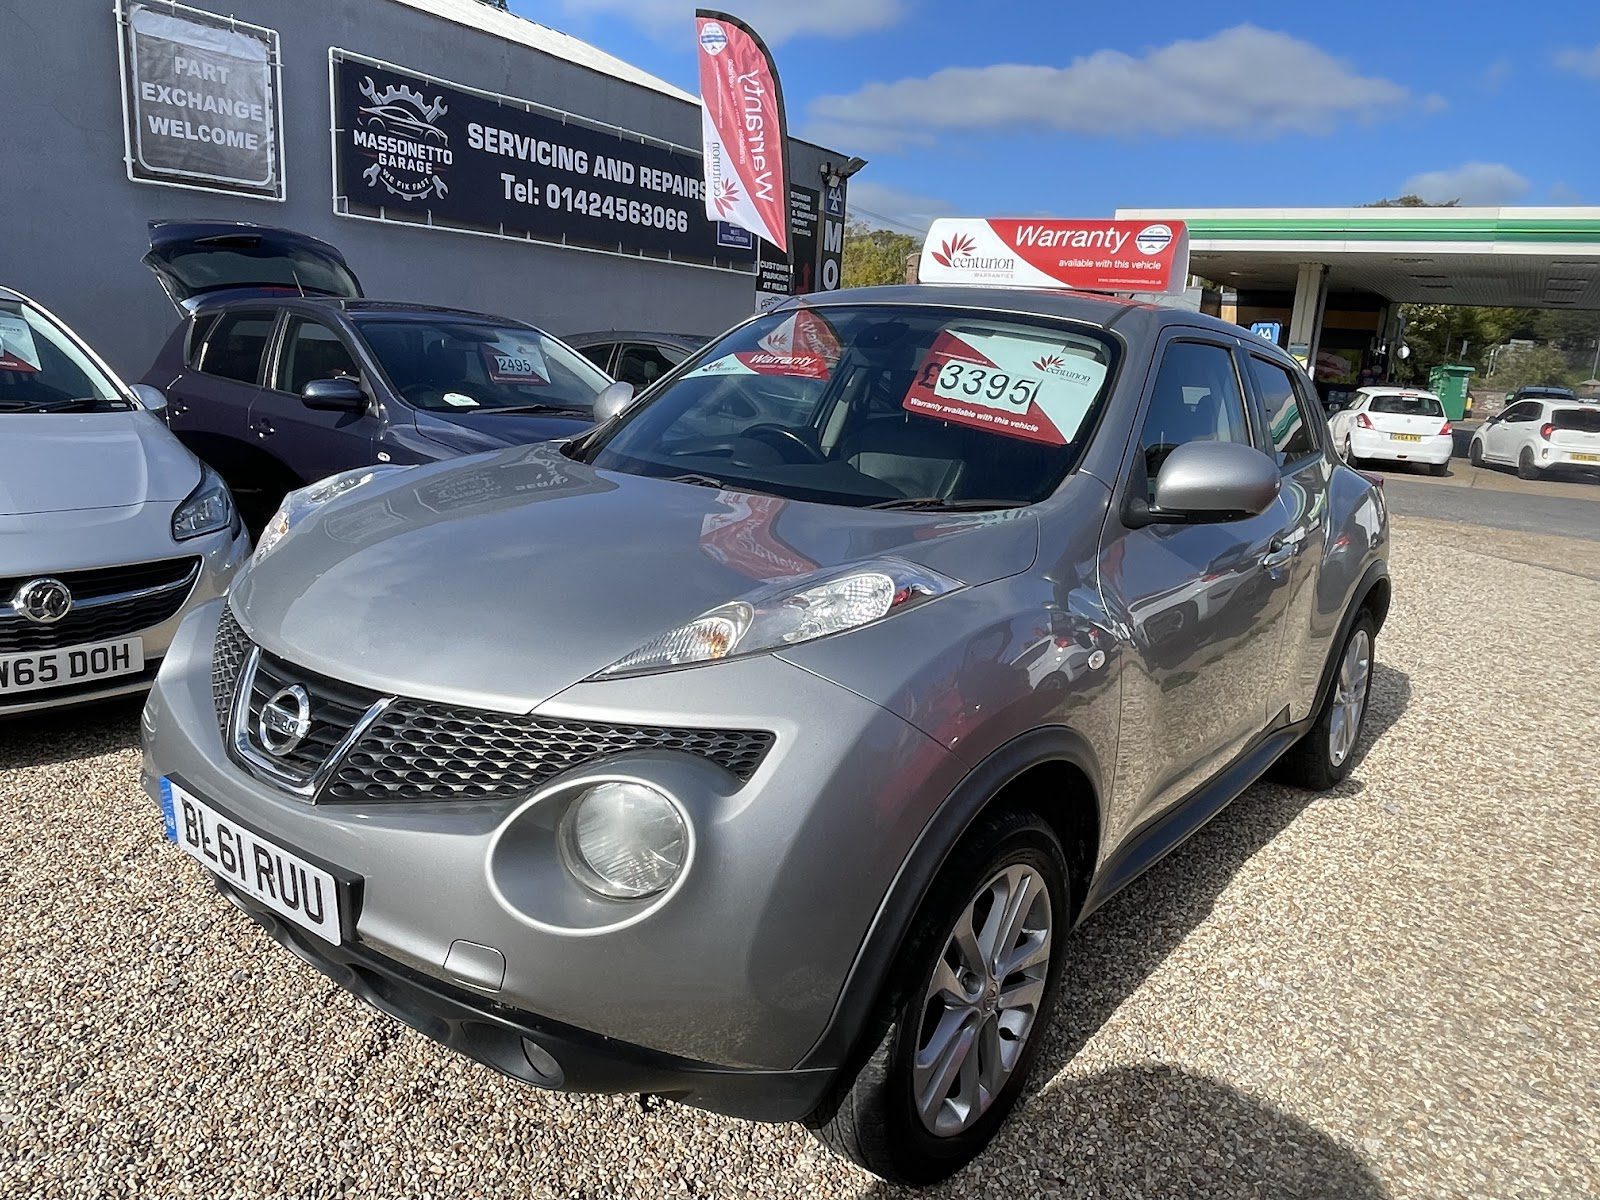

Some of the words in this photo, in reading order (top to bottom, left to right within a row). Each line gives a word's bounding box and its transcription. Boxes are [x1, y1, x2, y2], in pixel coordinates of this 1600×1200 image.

[175, 56, 230, 84] PART
[141, 82, 263, 121] EXCHANGE
[148, 115, 258, 150] WELCOME
[353, 129, 453, 165] MASSONETTO
[378, 152, 433, 174] GARAGE
[467, 122, 588, 174] SERVICING
[593, 155, 635, 185] AND
[639, 166, 706, 201] REPAIRS
[382, 168, 395, 184] WE
[397, 180, 410, 191] FIX
[412, 177, 430, 191] FAST
[500, 172, 540, 206] Tel:
[546, 183, 688, 233] 01424563066
[1016, 225, 1131, 254] Warranty
[760, 260, 789, 272] CUSTOME
[762, 271, 789, 282] PARKING
[953, 256, 1014, 270] centurion
[1059, 258, 1094, 268] available
[1095, 258, 1113, 268] with
[1114, 259, 1129, 269] this
[1131, 260, 1161, 270] vehicle
[763, 281, 771, 289] AT
[772, 283, 788, 292] REAR
[498, 358, 531, 372] 2495
[749, 354, 817, 367] Warranty
[910, 397, 942, 412] Warranty
[942, 405, 976, 418] available
[976, 412, 993, 422] with
[993, 415, 1009, 426] this
[1010, 420, 1039, 433] vehicle
[69, 643, 130, 678] DOH
[181, 797, 246, 882] BL61
[253, 842, 325, 926] RUU
